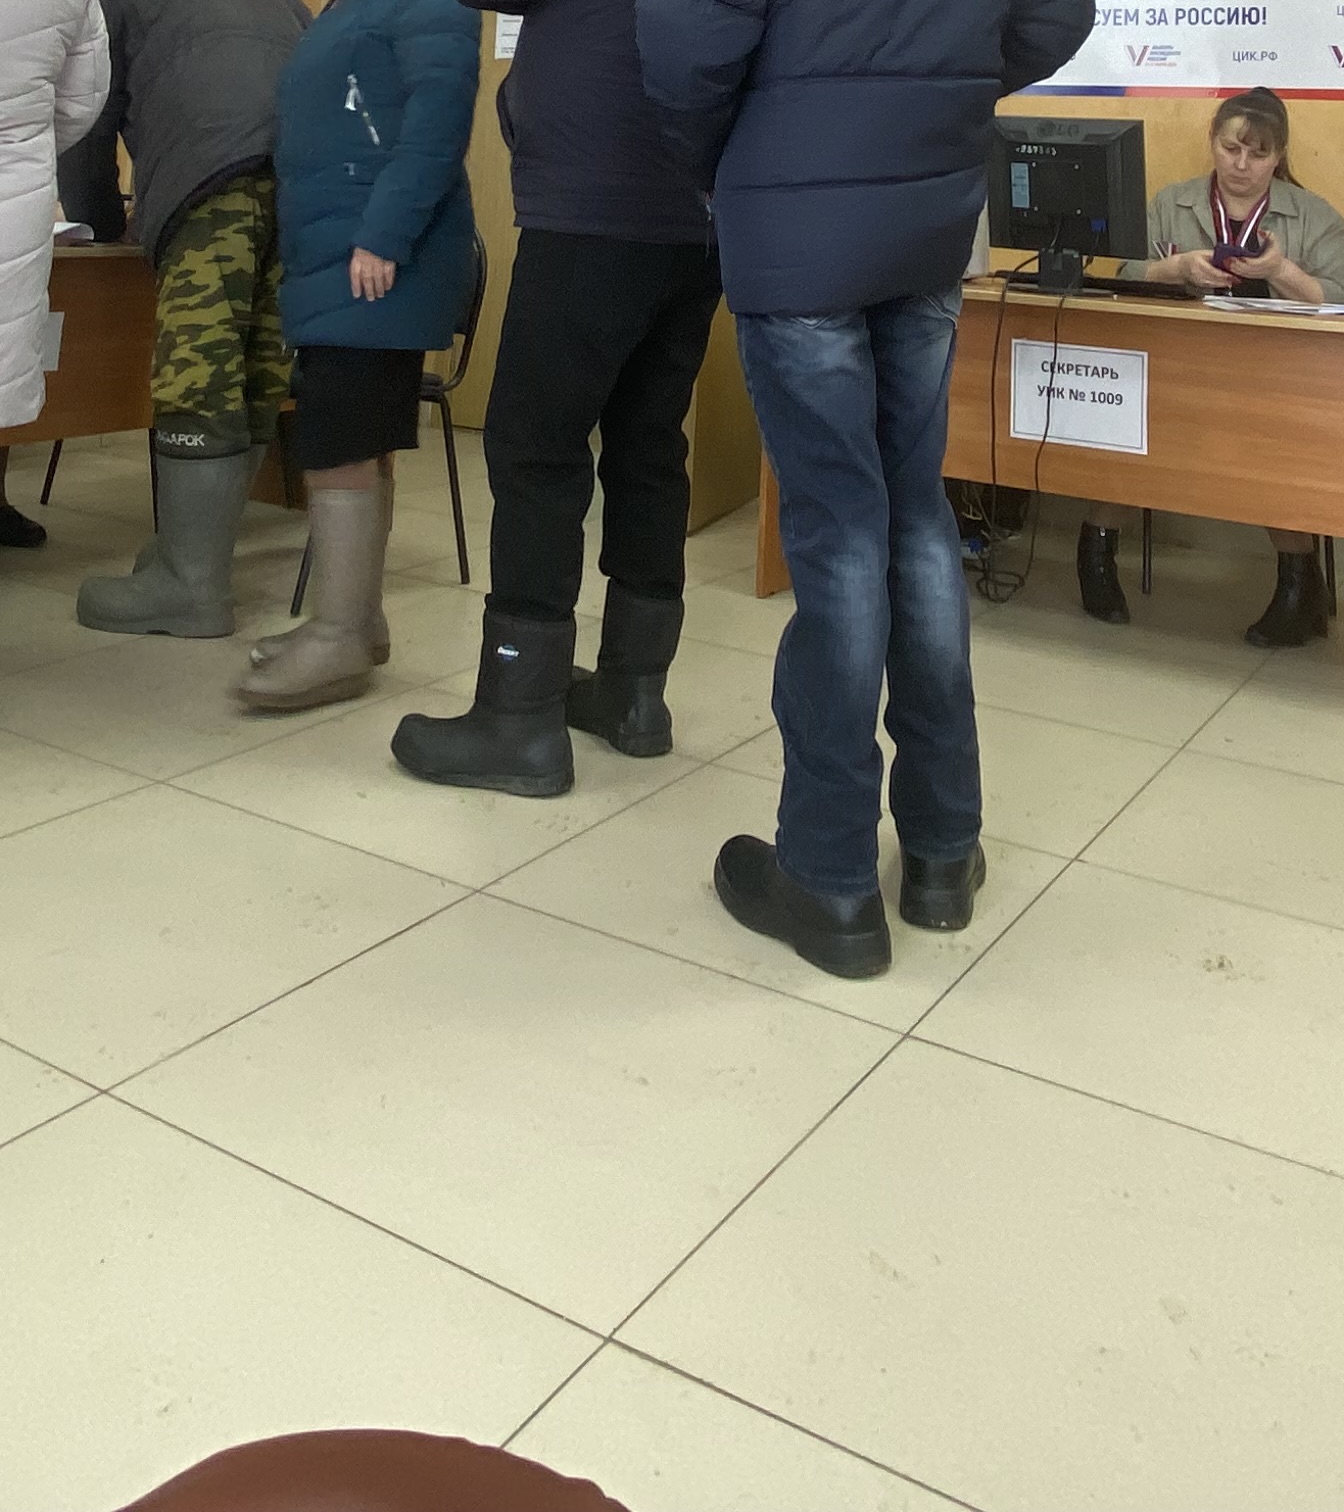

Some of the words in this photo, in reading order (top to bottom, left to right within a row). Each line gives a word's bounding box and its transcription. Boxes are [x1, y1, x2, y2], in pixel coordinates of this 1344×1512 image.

[1094, 8, 1139, 26] СУЕМ
[1145, 8, 1169, 26] ЗА
[1174, 6, 1267, 26] РОССИЮ!
[1232, 50, 1278, 63] ЦИК.РФ
[1041, 360, 1119, 380] СЕКРЕТАРЬ
[1037, 384, 1065, 400] УИК
[1069, 388, 1086, 402] №
[1090, 391, 1124, 406] 1009
